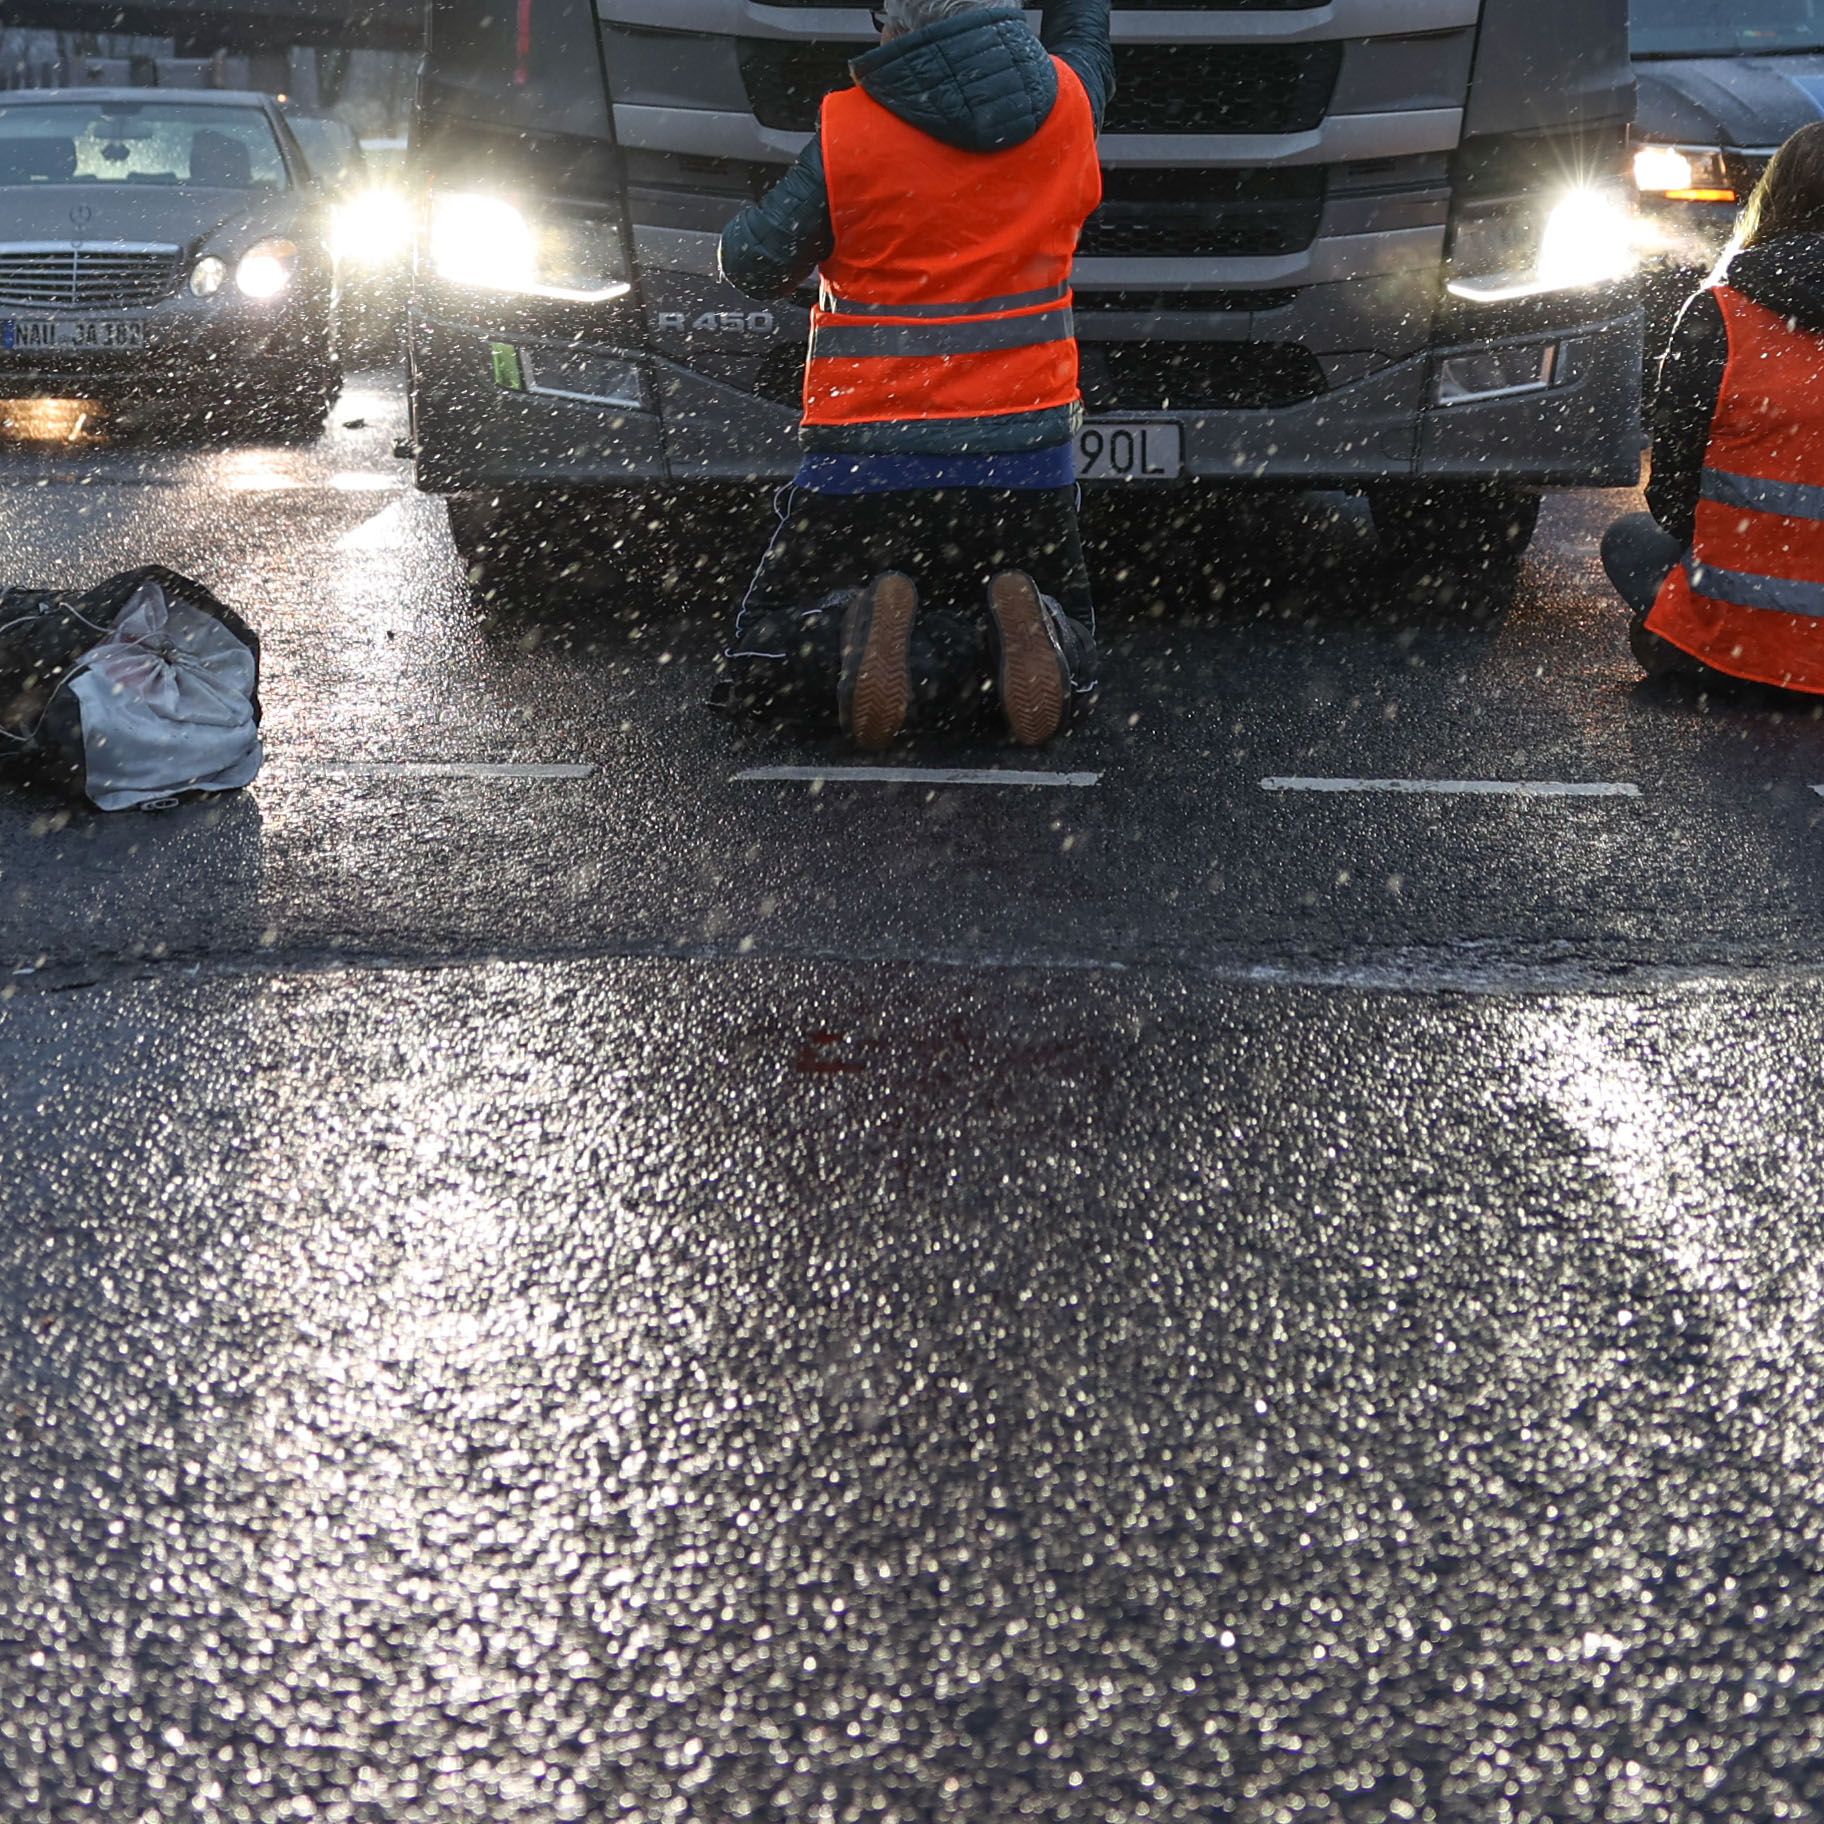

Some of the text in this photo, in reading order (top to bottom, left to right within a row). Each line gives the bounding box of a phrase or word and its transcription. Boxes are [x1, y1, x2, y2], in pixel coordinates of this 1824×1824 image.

[658, 312, 773, 333] R 450
[16, 324, 55, 344] NAU
[1080, 429, 1165, 474] 90L
